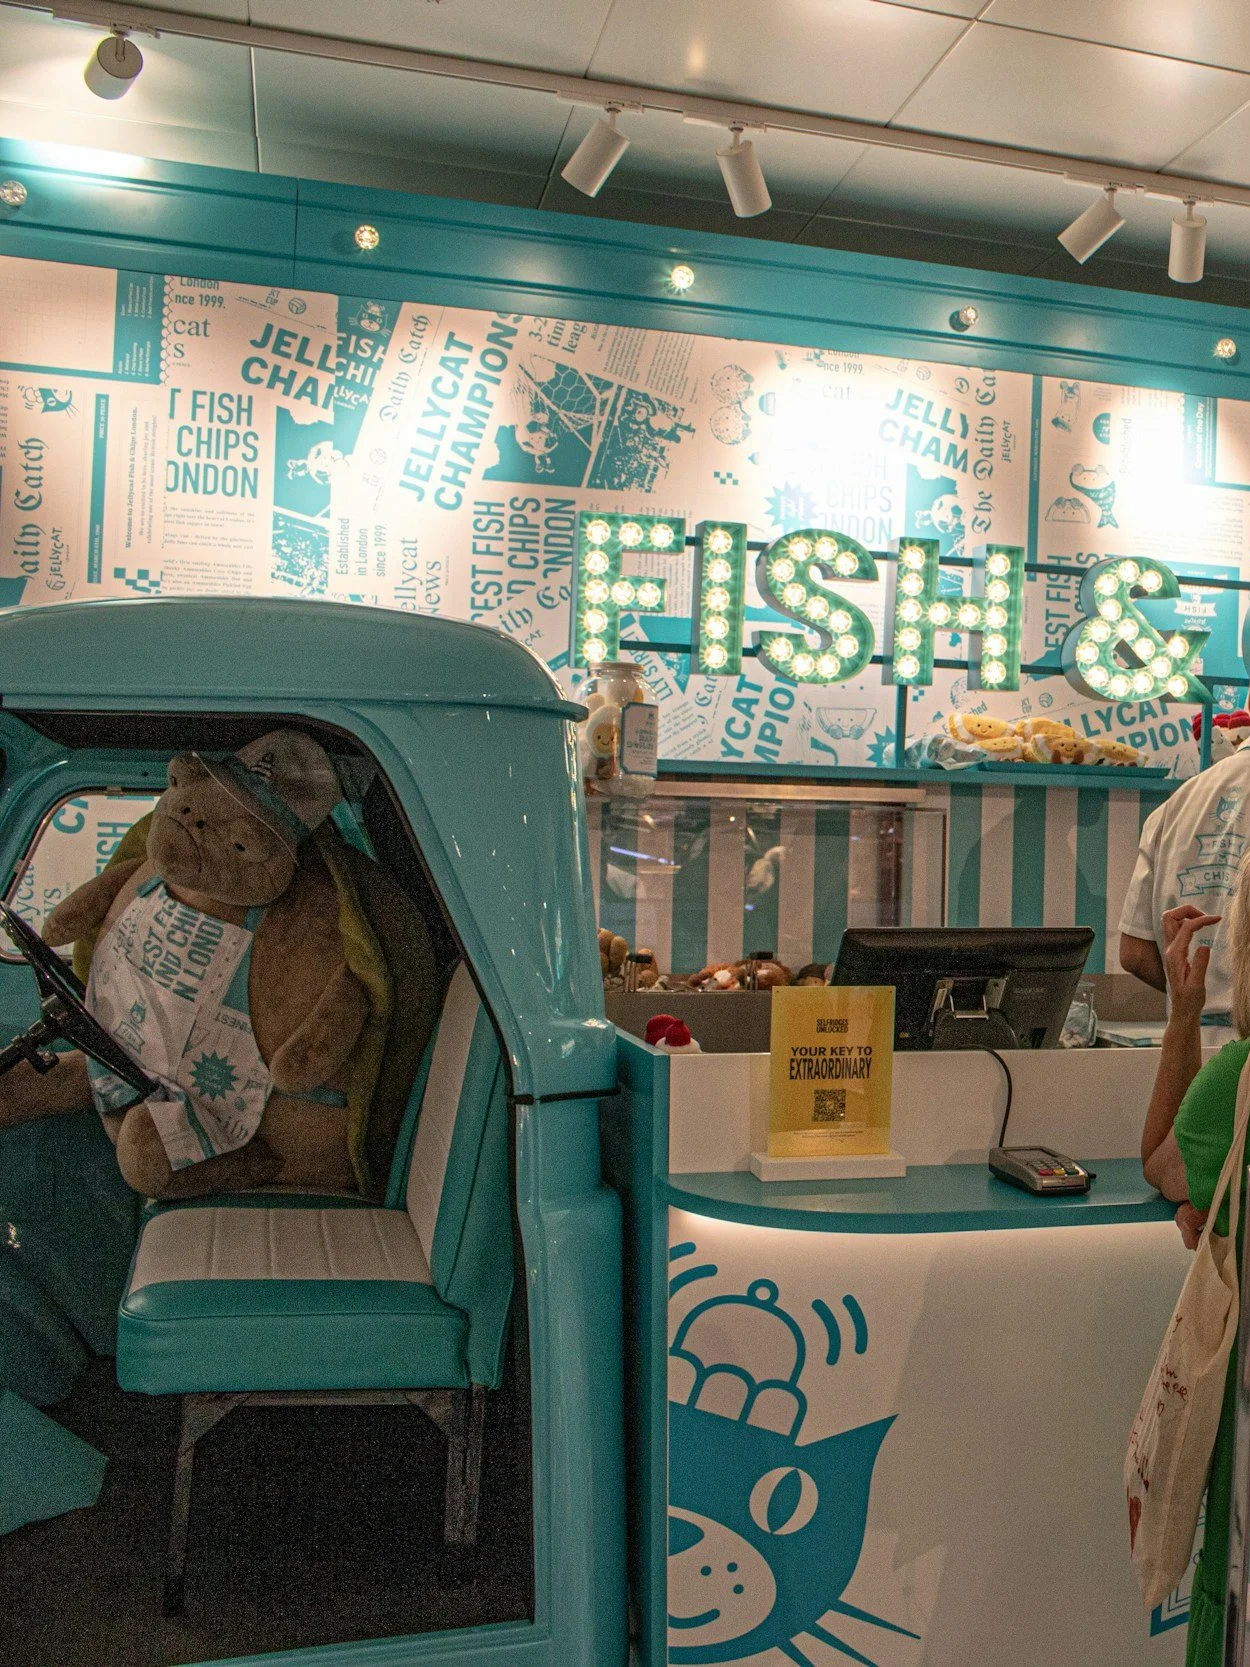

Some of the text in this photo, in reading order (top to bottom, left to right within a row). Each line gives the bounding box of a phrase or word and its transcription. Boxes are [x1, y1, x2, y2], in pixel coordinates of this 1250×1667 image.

[173, 319, 212, 338] cat
[398, 314, 433, 364] Catch
[190, 390, 254, 428] FISH
[399, 331, 474, 503] JELLYCAT
[1196, 402, 1207, 419] Day
[177, 425, 260, 463] CHIPS
[973, 416, 999, 481] Daily
[1000, 420, 1012, 464] JELLYCAT
[13, 437, 50, 580] aily Catch
[127, 480, 135, 507] Jellycat
[972, 490, 996, 534] The
[49, 527, 65, 578] JELLYCAT
[125, 517, 133, 548] Welcome
[336, 518, 350, 576] Established
[356, 528, 368, 577] in London
[507, 496, 541, 570] CHIPS
[375, 549, 387, 577] since
[394, 538, 423, 610] ellycat
[471, 501, 505, 623] EST FISH
[1045, 554, 1071, 603] FISH
[573, 511, 1024, 691] FISH
[1061, 556, 1212, 703] &
[183, 911, 226, 981] LOND
[789, 1058, 872, 1080] EXTRAORDINARY
[791, 1046, 872, 1056] YOUR KEY TO
